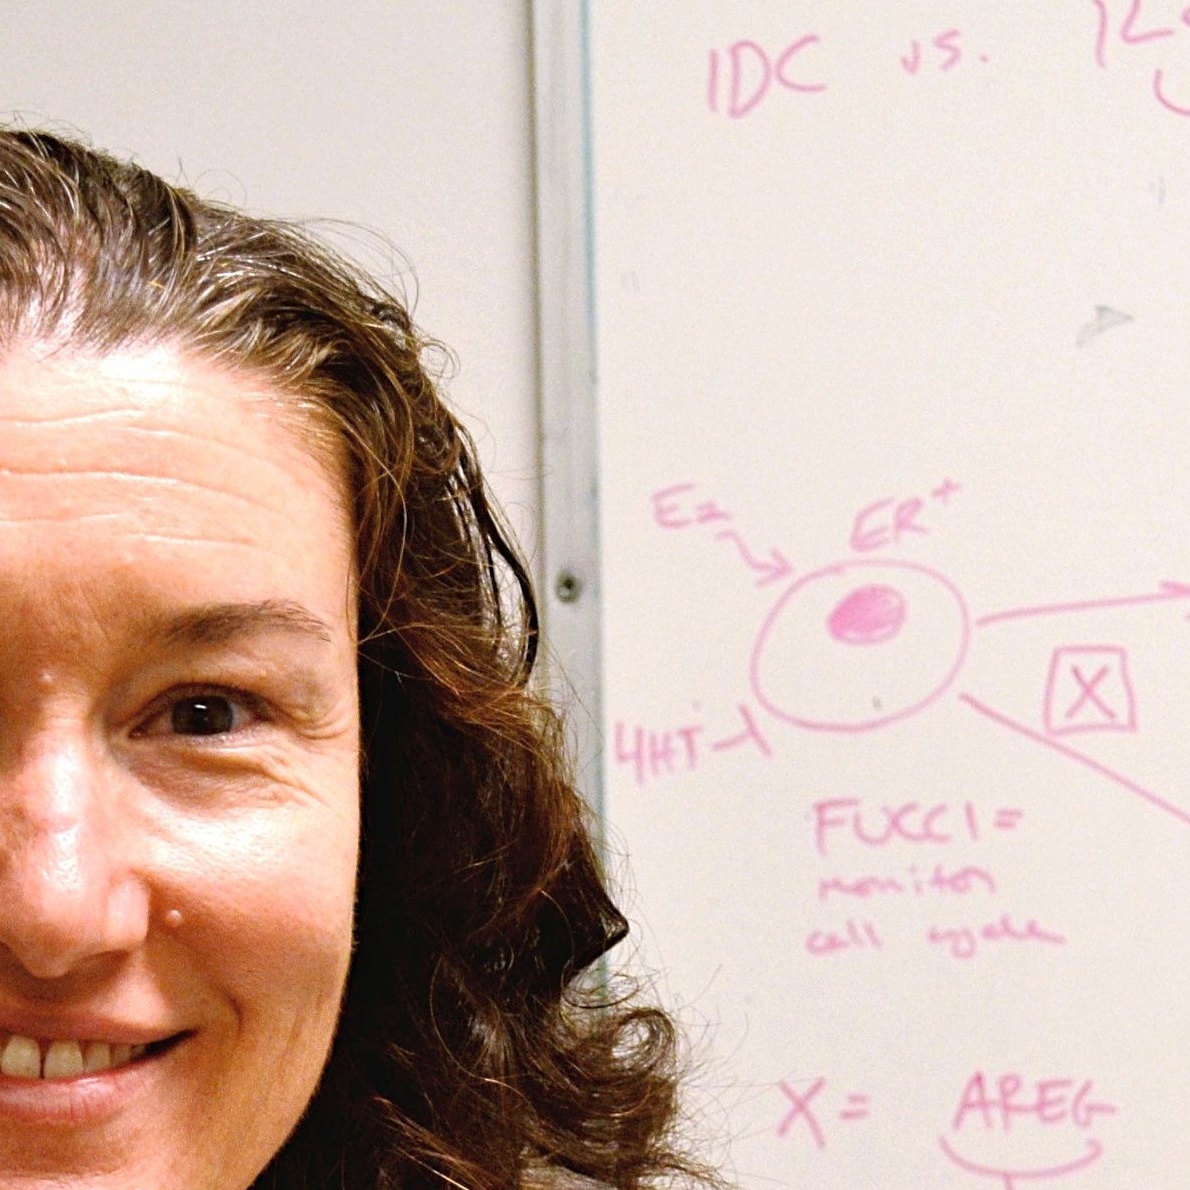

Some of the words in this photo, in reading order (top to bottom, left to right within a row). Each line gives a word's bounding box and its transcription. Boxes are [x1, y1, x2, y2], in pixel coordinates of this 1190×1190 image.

[708, 34, 825, 119] IDC
[1066, 666, 1116, 718] X
[614, 722, 704, 786] 4HT
[952, 1070, 1118, 1133] AREG
